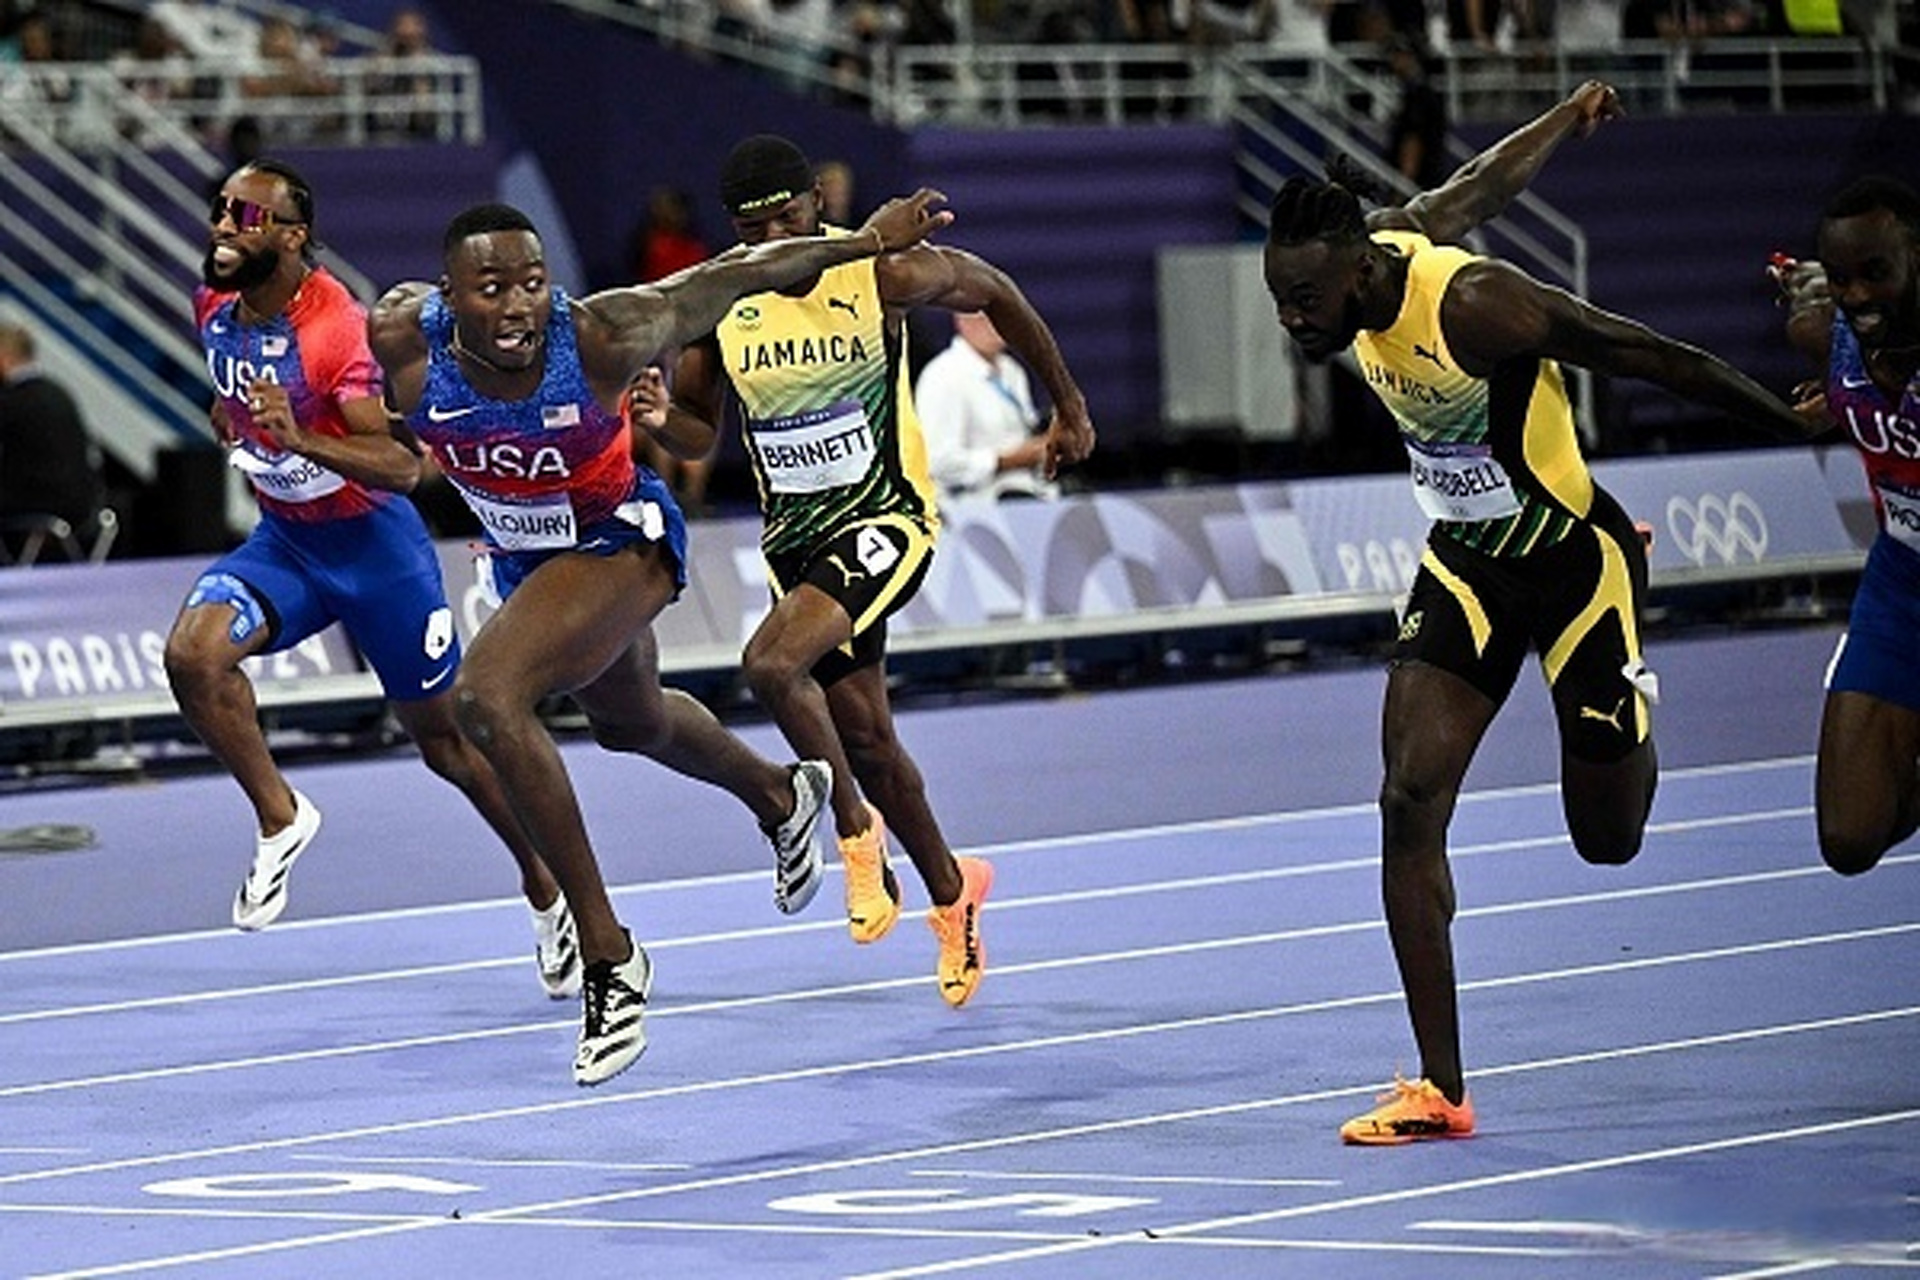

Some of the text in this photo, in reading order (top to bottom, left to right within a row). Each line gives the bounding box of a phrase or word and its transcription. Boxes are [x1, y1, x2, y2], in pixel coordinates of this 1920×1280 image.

[739, 334, 868, 374] JAMAICA
[446, 444, 571, 480] USA
[762, 425, 869, 469] BENNETT
[865, 536, 885, 560] 7
[9, 629, 167, 698] PARIS
